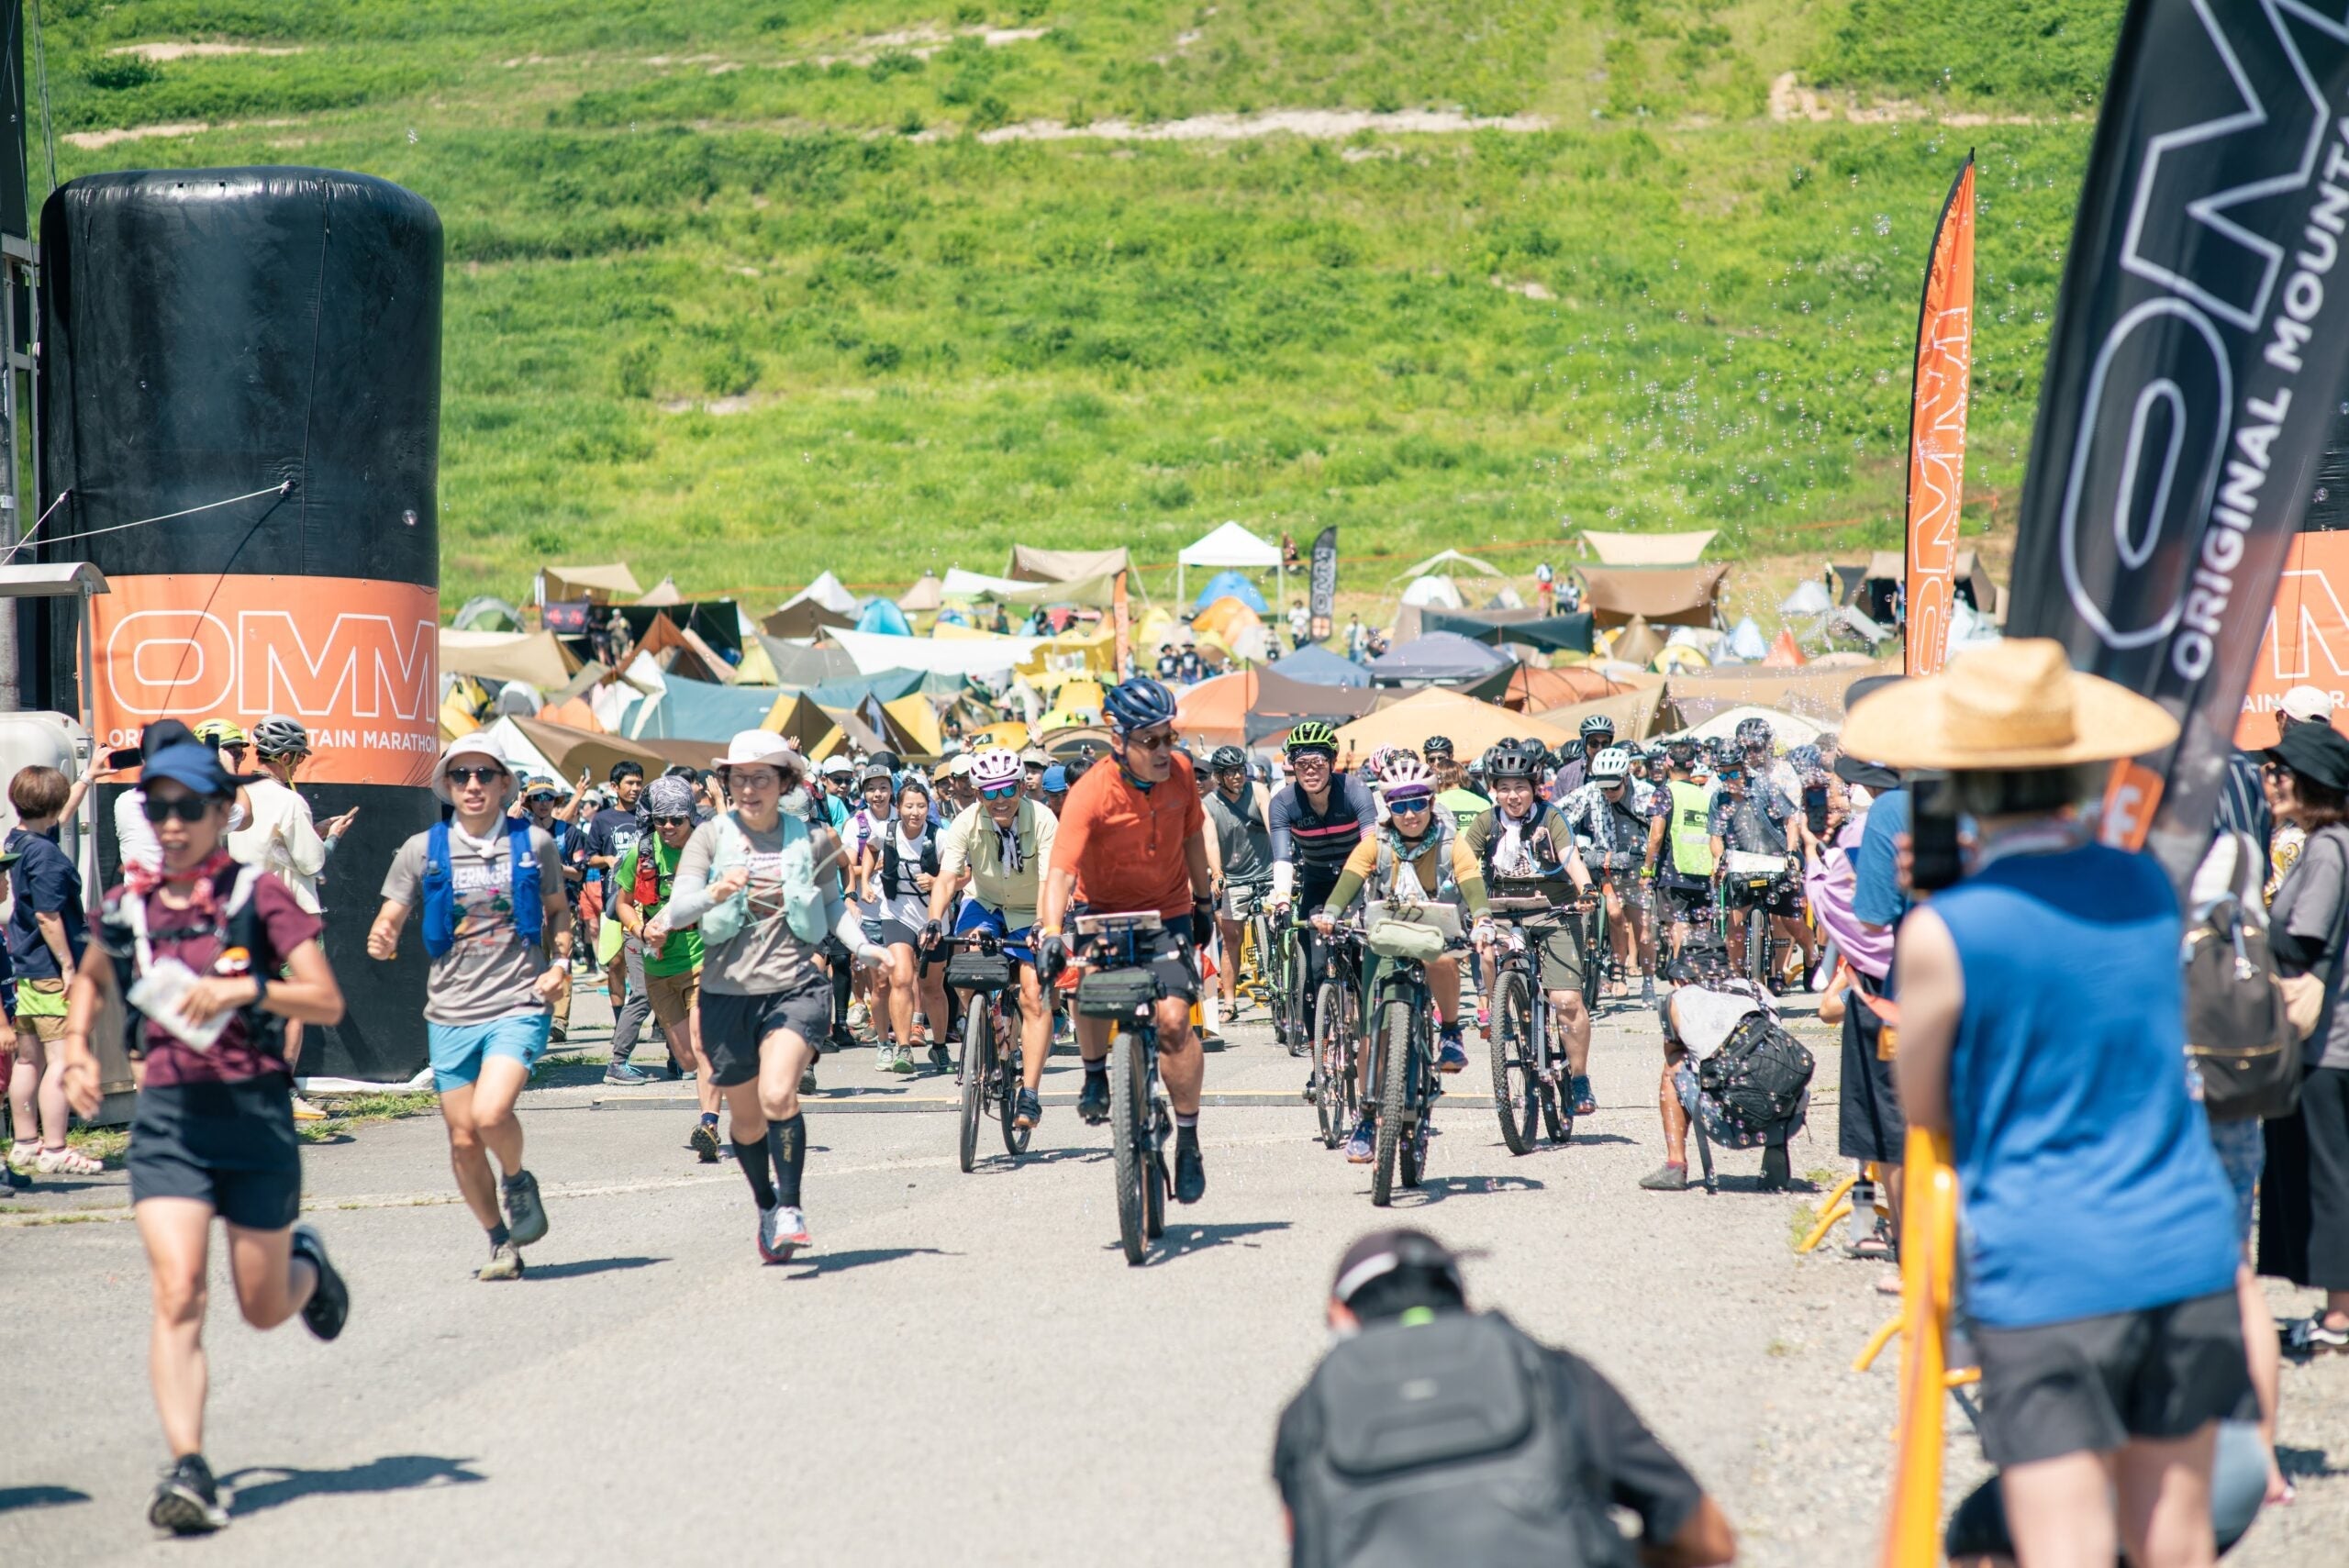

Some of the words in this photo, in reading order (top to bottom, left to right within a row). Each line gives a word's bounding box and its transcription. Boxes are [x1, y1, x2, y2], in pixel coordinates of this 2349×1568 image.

[2060, 0, 2349, 650] OM
[2173, 386, 2293, 681] ORIGINAL
[2264, 87, 2349, 373] MOUNT
[107, 609, 437, 724] OMM
[362, 731, 437, 754] MARATHON
